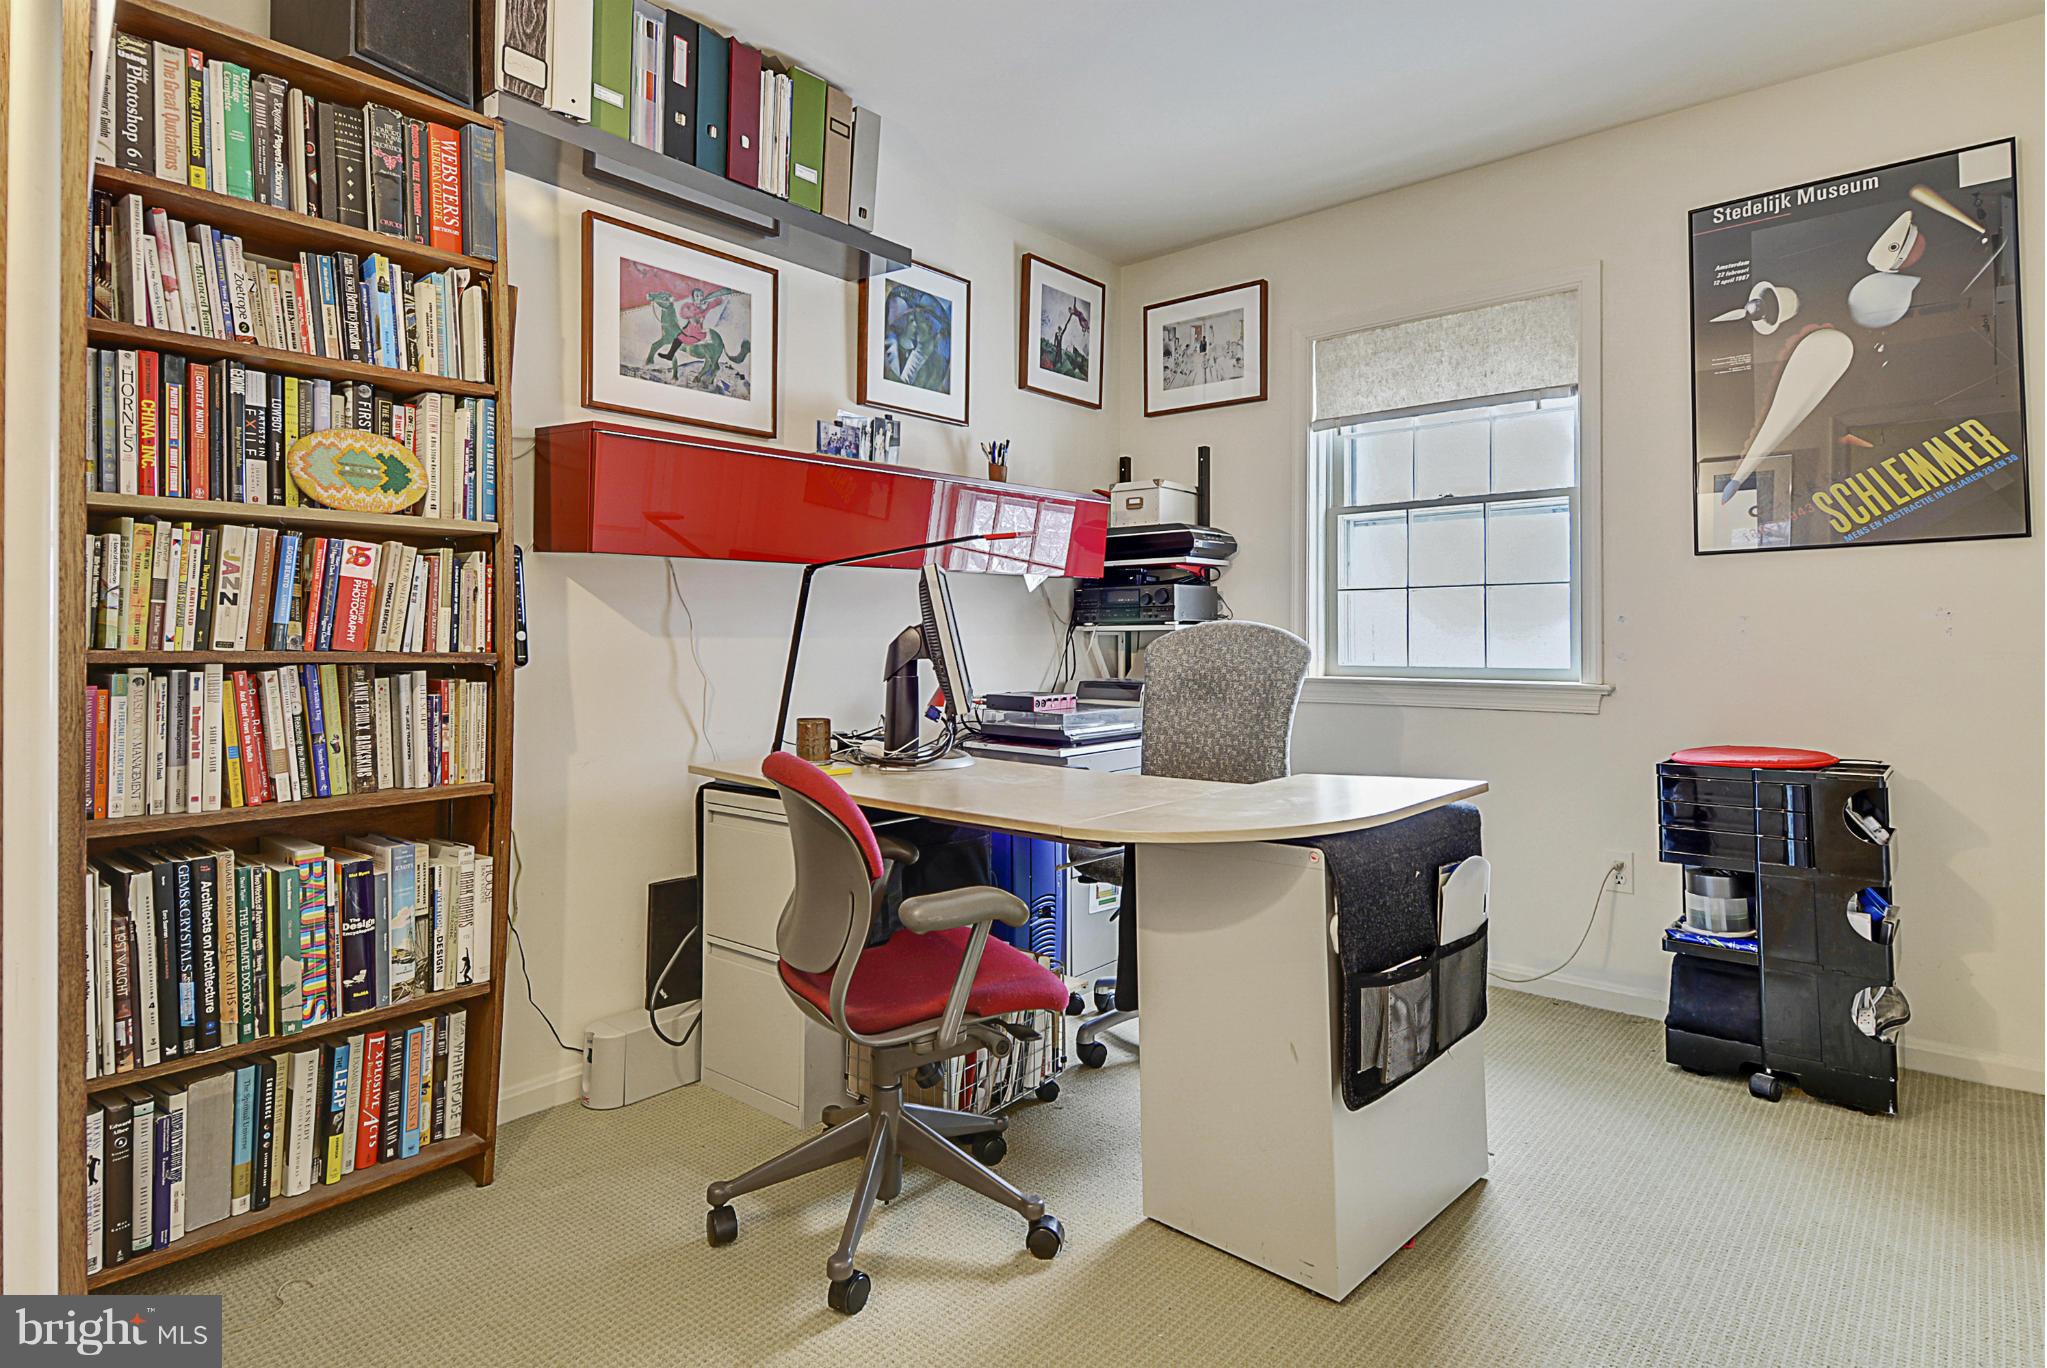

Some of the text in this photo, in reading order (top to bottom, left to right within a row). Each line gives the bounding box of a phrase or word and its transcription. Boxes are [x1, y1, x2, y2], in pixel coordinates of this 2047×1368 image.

[122, 62, 143, 143] Photoshop
[162, 59, 181, 171] The Great Quotations
[188, 79, 204, 159] Bridge Dummies
[126, 148, 142, 159] 6
[270, 134, 283, 201] Players Dictionary
[431, 137, 443, 221] AMERICAN COLLEGE
[440, 140, 460, 227] WEBSTER'S
[1713, 176, 1879, 224] Stedelijk Museum
[1714, 260, 1750, 272] Amsterdam
[1720, 278, 1735, 286] april
[222, 301, 230, 314] 50
[233, 272, 248, 320] Zoetrope
[121, 370, 134, 453] HORNES
[195, 375, 204, 408] CONTENT
[382, 405, 390, 418] THE
[140, 399, 156, 469] CHINA INC.
[195, 409, 204, 434] NATION
[244, 408, 256, 456] EXILE
[258, 409, 266, 456] ARTISTS IN
[271, 398, 282, 434] LOWBOY
[487, 444, 496, 485] SYMMETRY
[1812, 419, 2010, 533] SCHLEMMER
[1843, 526, 1870, 543] MENS
[1870, 520, 1883, 531] EN
[1882, 495, 1935, 526] ABSTRACTIE
[1934, 490, 1946, 500] IN
[1983, 466, 1996, 476] 20
[1994, 460, 2008, 470] EN
[2006, 454, 2019, 464] 30
[219, 550, 240, 606] JAZZ
[282, 545, 294, 588] GOOD BENITO
[346, 578, 362, 642] PHOTOGRAPHY
[358, 598, 366, 624] CENTURY
[381, 582, 394, 634] THOMAS BERGER
[133, 689, 143, 725] MASLOW
[175, 696, 184, 760] Project Management
[239, 690, 254, 762] And Quiet Flows the Vodka
[294, 716, 304, 746] Reaching
[354, 682, 372, 778] ANNIE PROULX BARKSKINS
[116, 769, 124, 794] PROGRAM
[130, 742, 142, 800] MANAGEMENT
[298, 758, 308, 779] Animal
[302, 780, 310, 796] Mind
[239, 907, 248, 927] THE
[458, 870, 474, 928] MARK MORRIS
[256, 931, 264, 951] Wyeth
[300, 860, 328, 1026] BAUHAUS
[342, 918, 376, 932] Design
[115, 932, 128, 996] LOST WRIGHT
[200, 880, 216, 1014] Architects on Architecture
[224, 896, 238, 1006] BOOK OF GREEK MYTHS
[240, 928, 250, 972] ULTIMATE
[436, 936, 444, 974] DESIGN
[242, 973, 250, 992] DOG
[242, 992, 252, 1016] BOOK
[390, 1036, 402, 1050] LOS
[424, 1025, 432, 1038] How
[424, 1040, 432, 1054] Dogs
[333, 1068, 348, 1108] LEAP
[389, 1053, 402, 1081] ALAMOS
[408, 1042, 422, 1122] GREAT BOOKS
[450, 1040, 464, 1121] WHITE NOISE
[241, 1094, 250, 1121] Spiritual
[264, 1078, 274, 1119] EMERGENCE
[304, 1060, 314, 1142] ROBERT KENNEDY
[362, 1036, 386, 1148] EXPLOSIVE ACTS
[388, 1090, 400, 1117] JOSEPH
[241, 1122, 249, 1150] Universe
